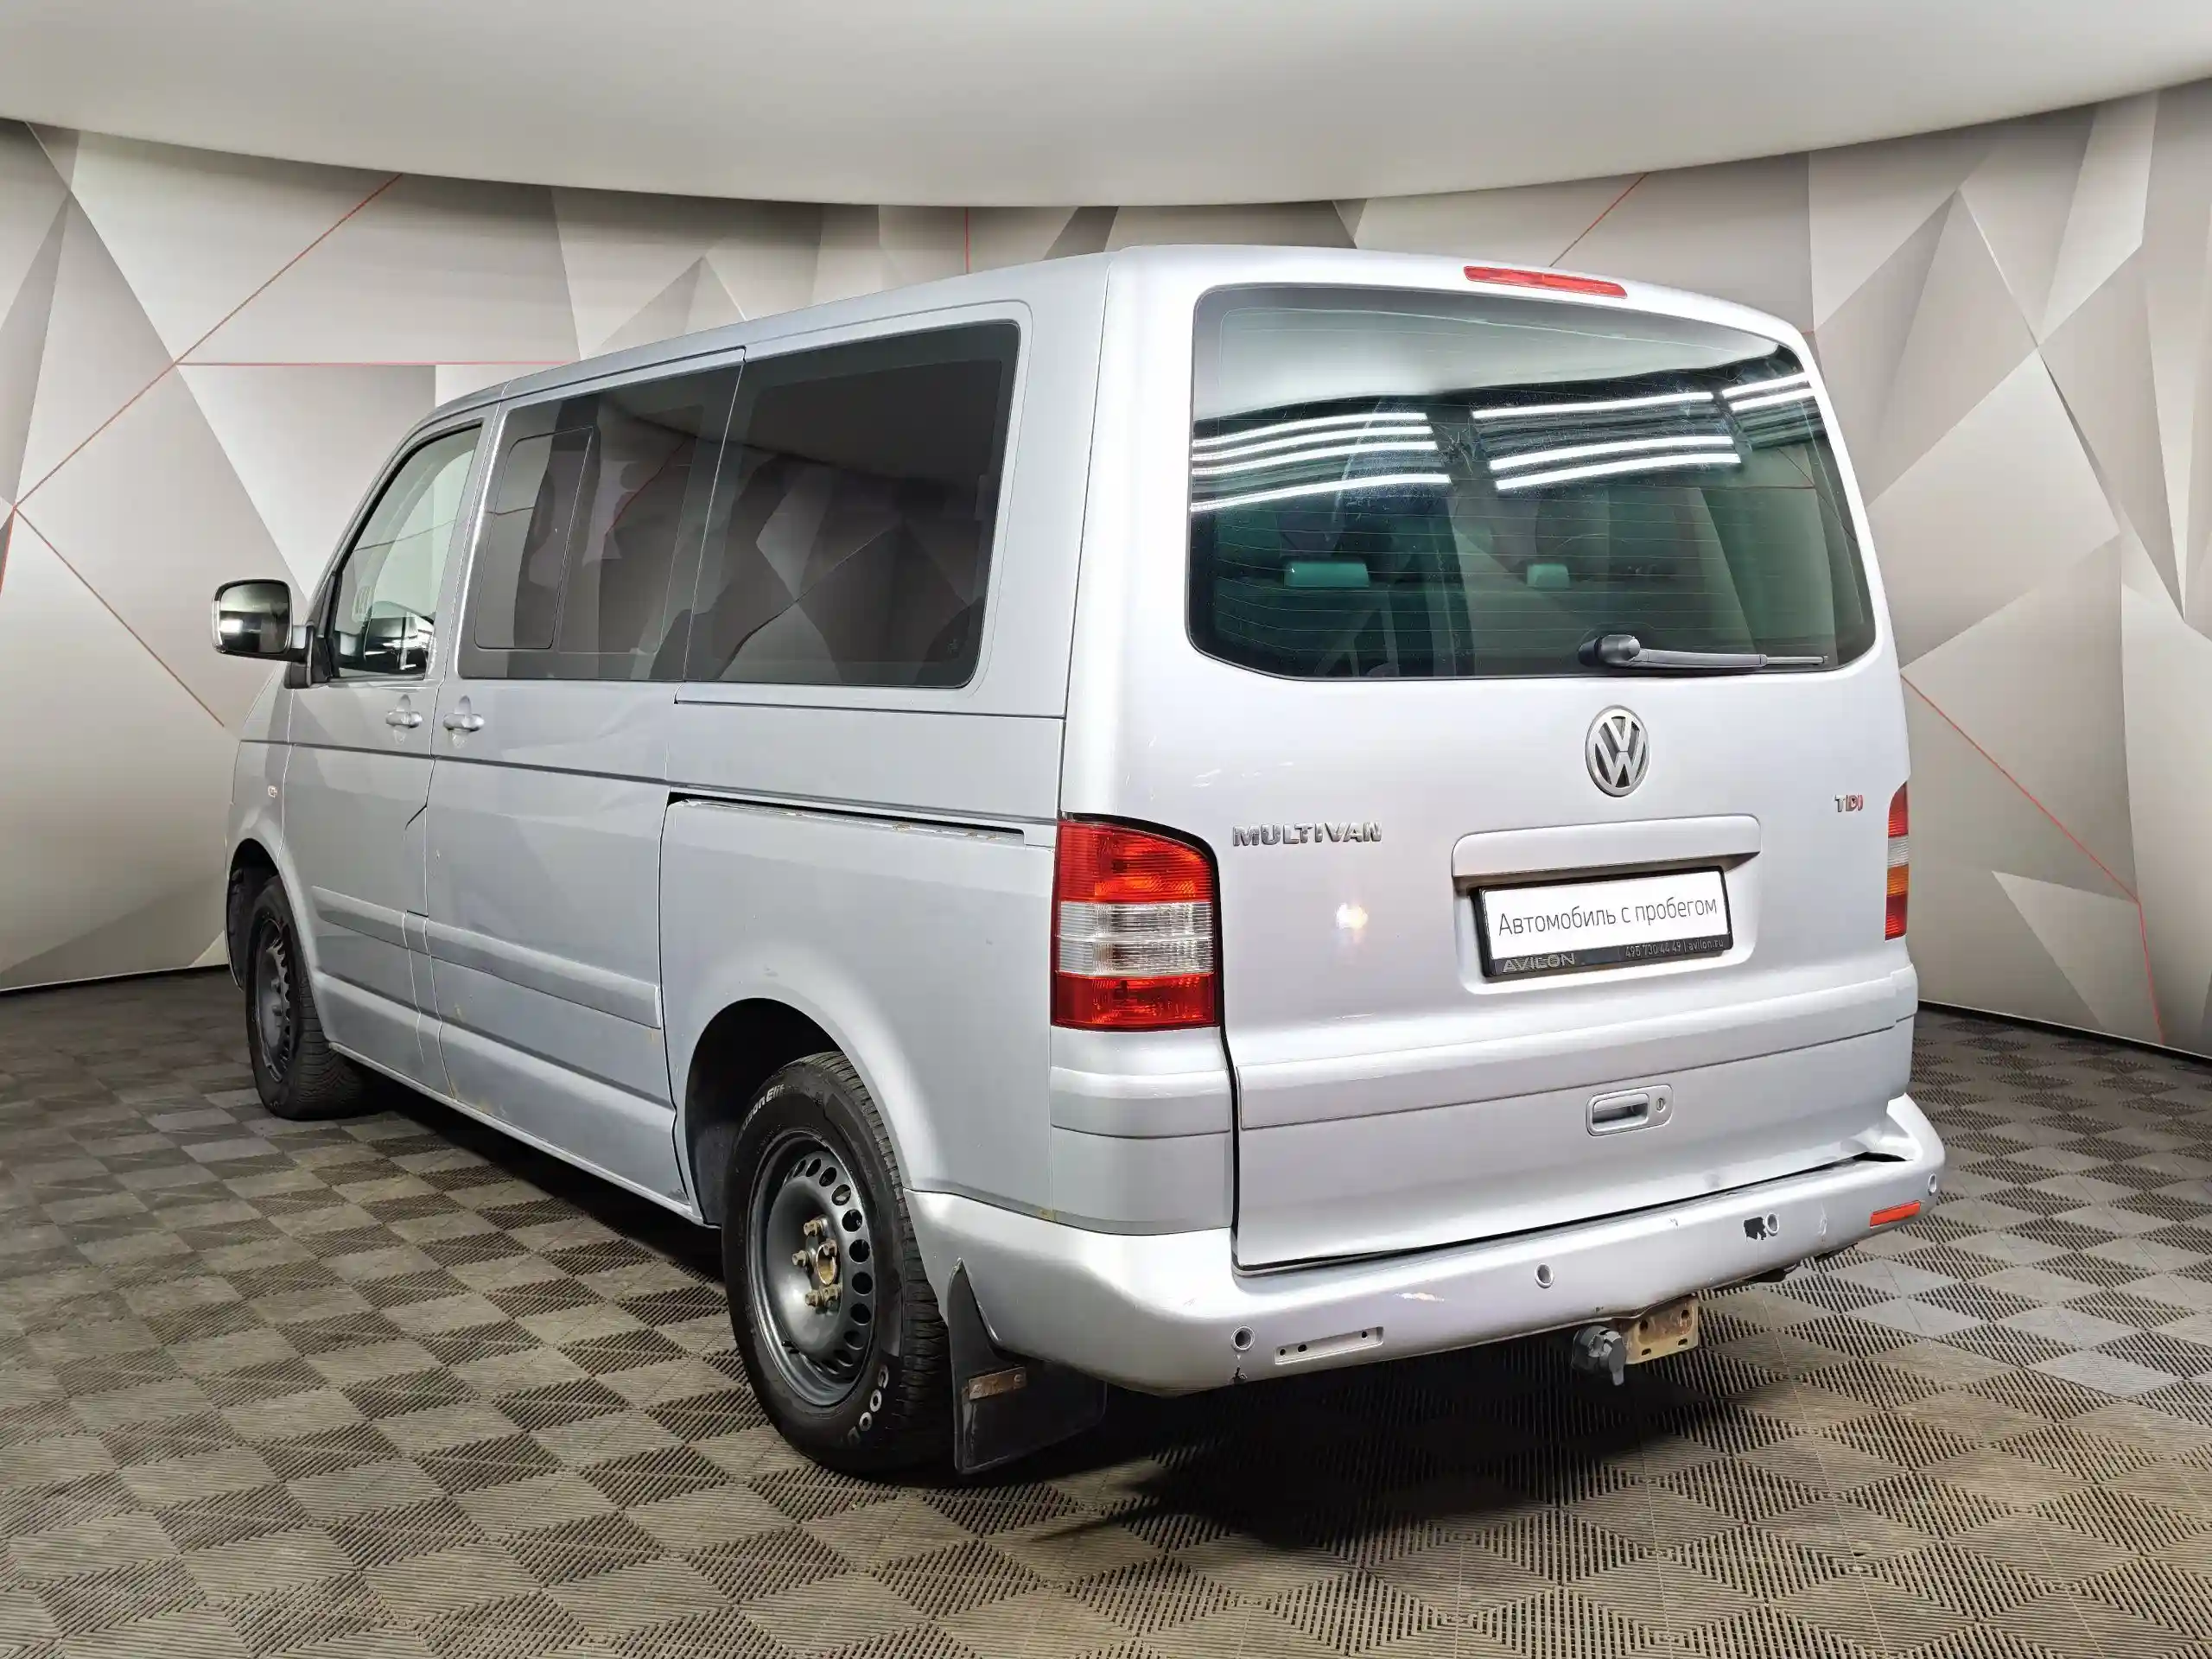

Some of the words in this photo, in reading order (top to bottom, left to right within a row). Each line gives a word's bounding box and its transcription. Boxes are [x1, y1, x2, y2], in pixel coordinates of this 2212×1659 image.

[1588, 708, 1649, 794] VW
[1834, 793, 1864, 812] TDI
[1232, 821, 1382, 847] MULTIVAN
[1498, 906, 1617, 936] Автомобиль
[1621, 906, 1630, 924] с
[1635, 896, 1718, 926] пробегом
[1625, 945, 1641, 958] 495
[1688, 938, 1725, 950] avilon.ru
[1502, 952, 1576, 974] AVILON
